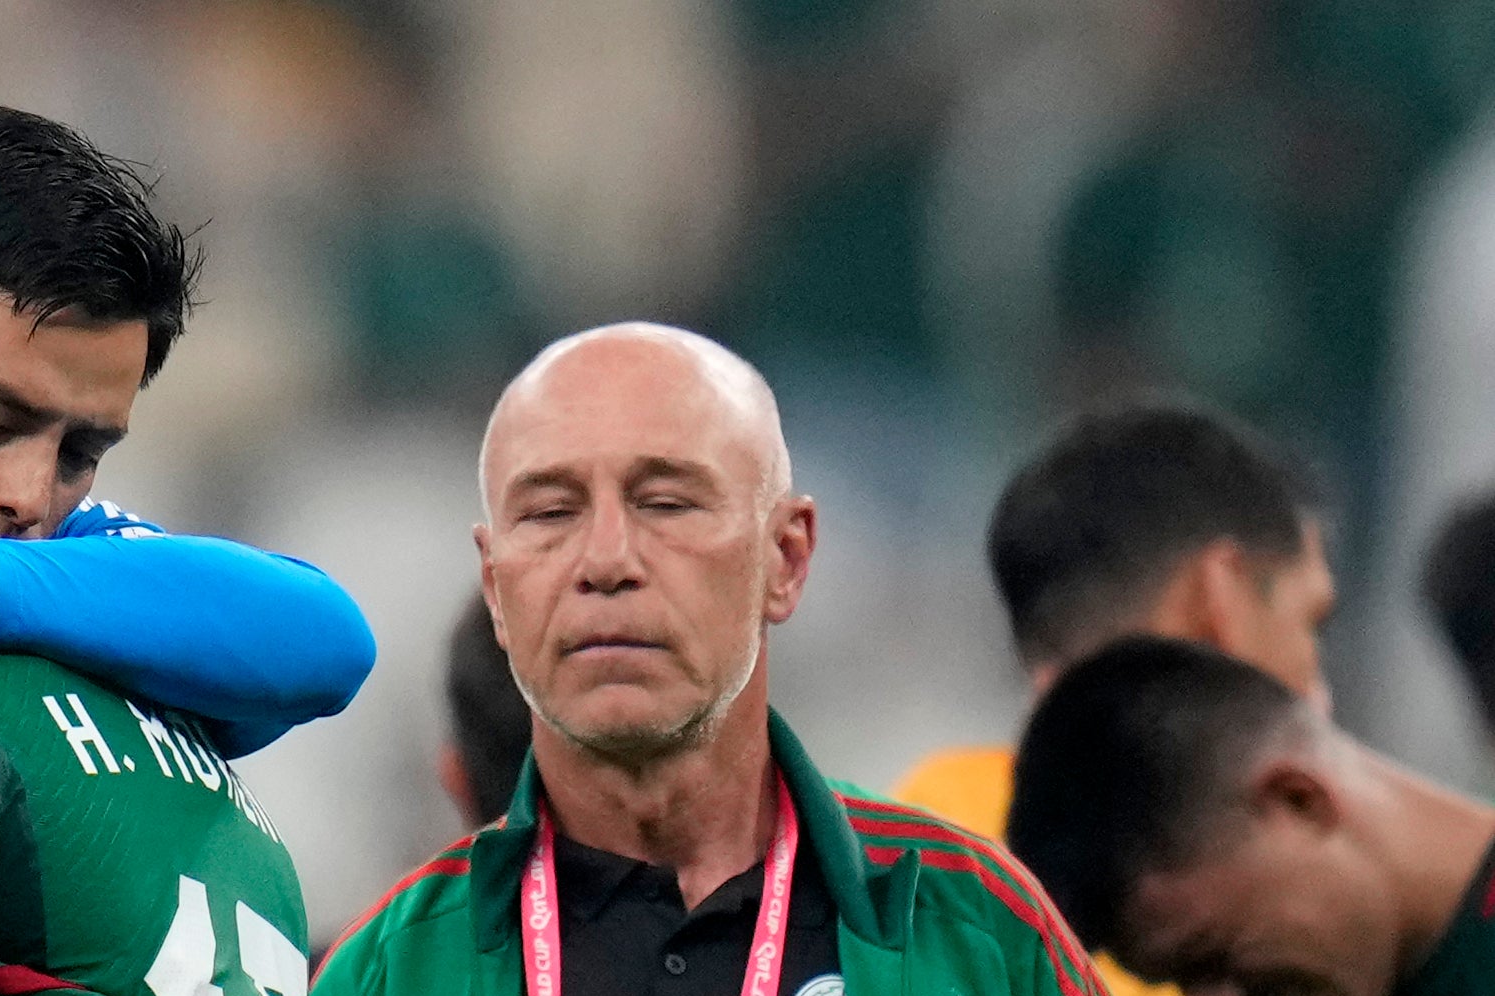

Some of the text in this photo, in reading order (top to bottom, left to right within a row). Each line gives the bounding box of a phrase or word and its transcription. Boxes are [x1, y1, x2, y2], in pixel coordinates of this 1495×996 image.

[43, 694, 135, 775] H.
[767, 899, 783, 936] CUP
[534, 938, 551, 971] CUP
